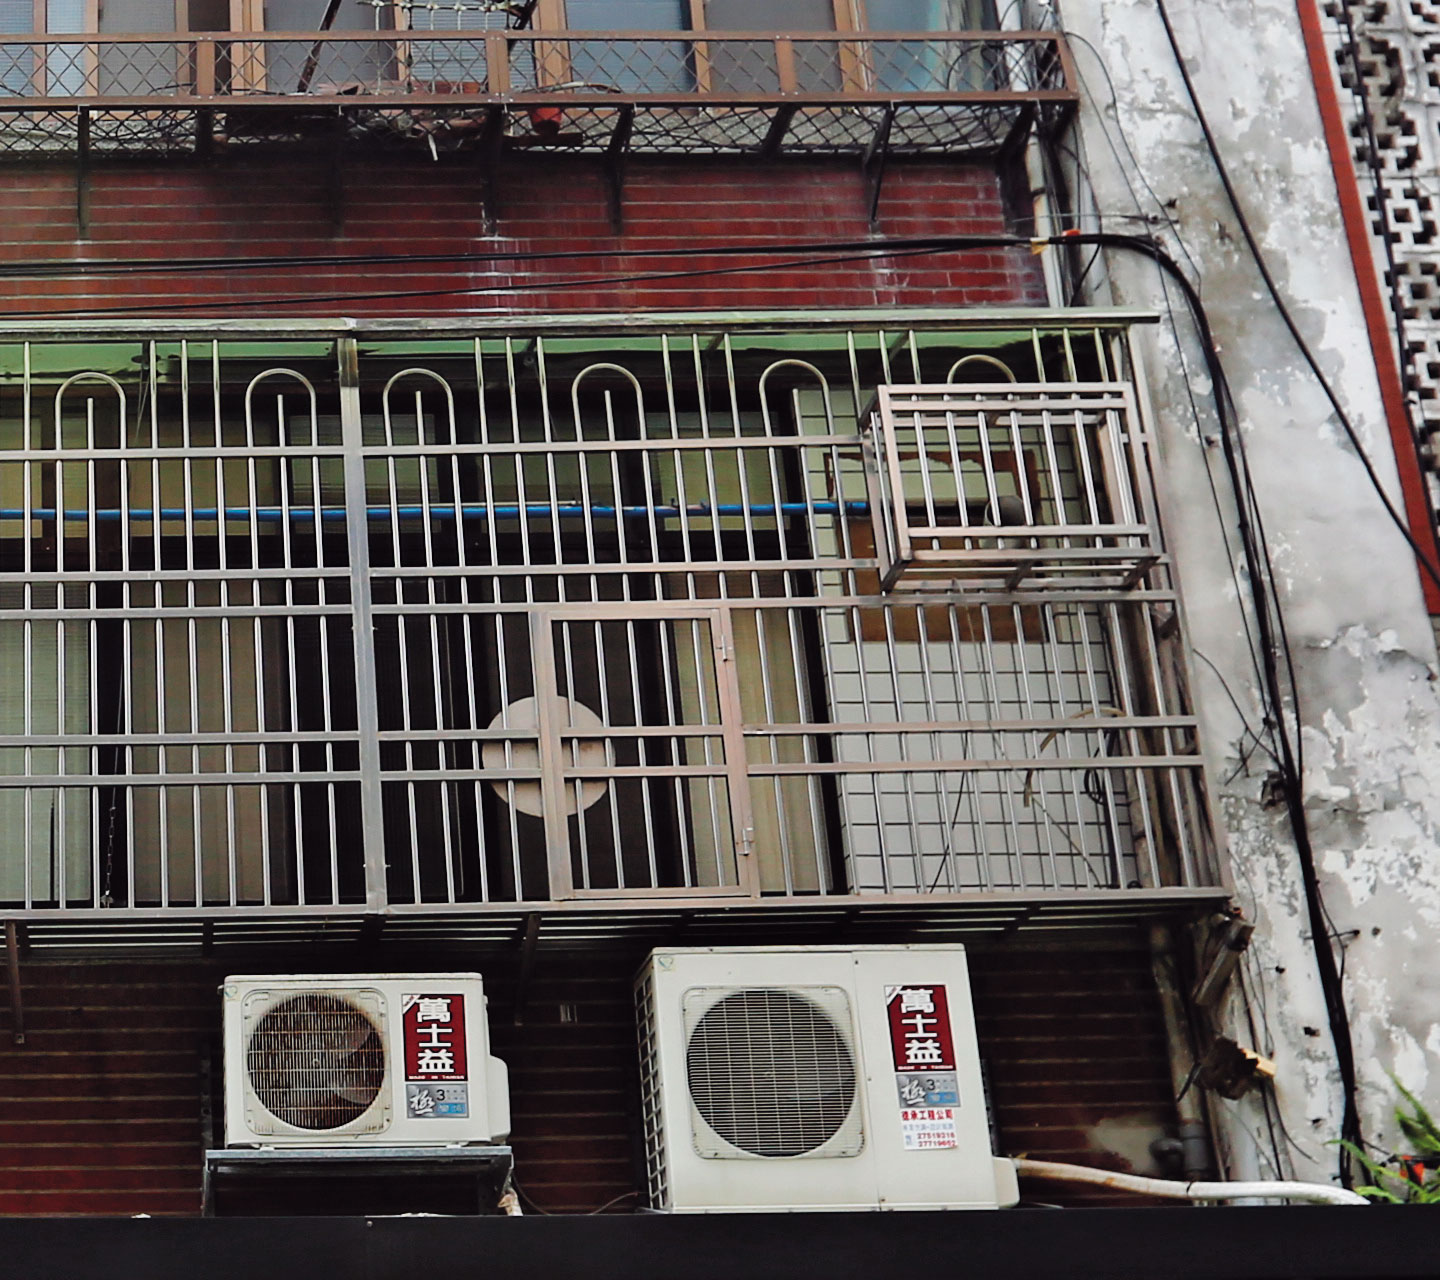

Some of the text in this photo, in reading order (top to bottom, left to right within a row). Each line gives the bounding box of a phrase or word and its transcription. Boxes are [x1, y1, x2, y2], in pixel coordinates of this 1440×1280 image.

[416, 998, 455, 1073] 萬士益
[898, 989, 943, 1064] 萬士益
